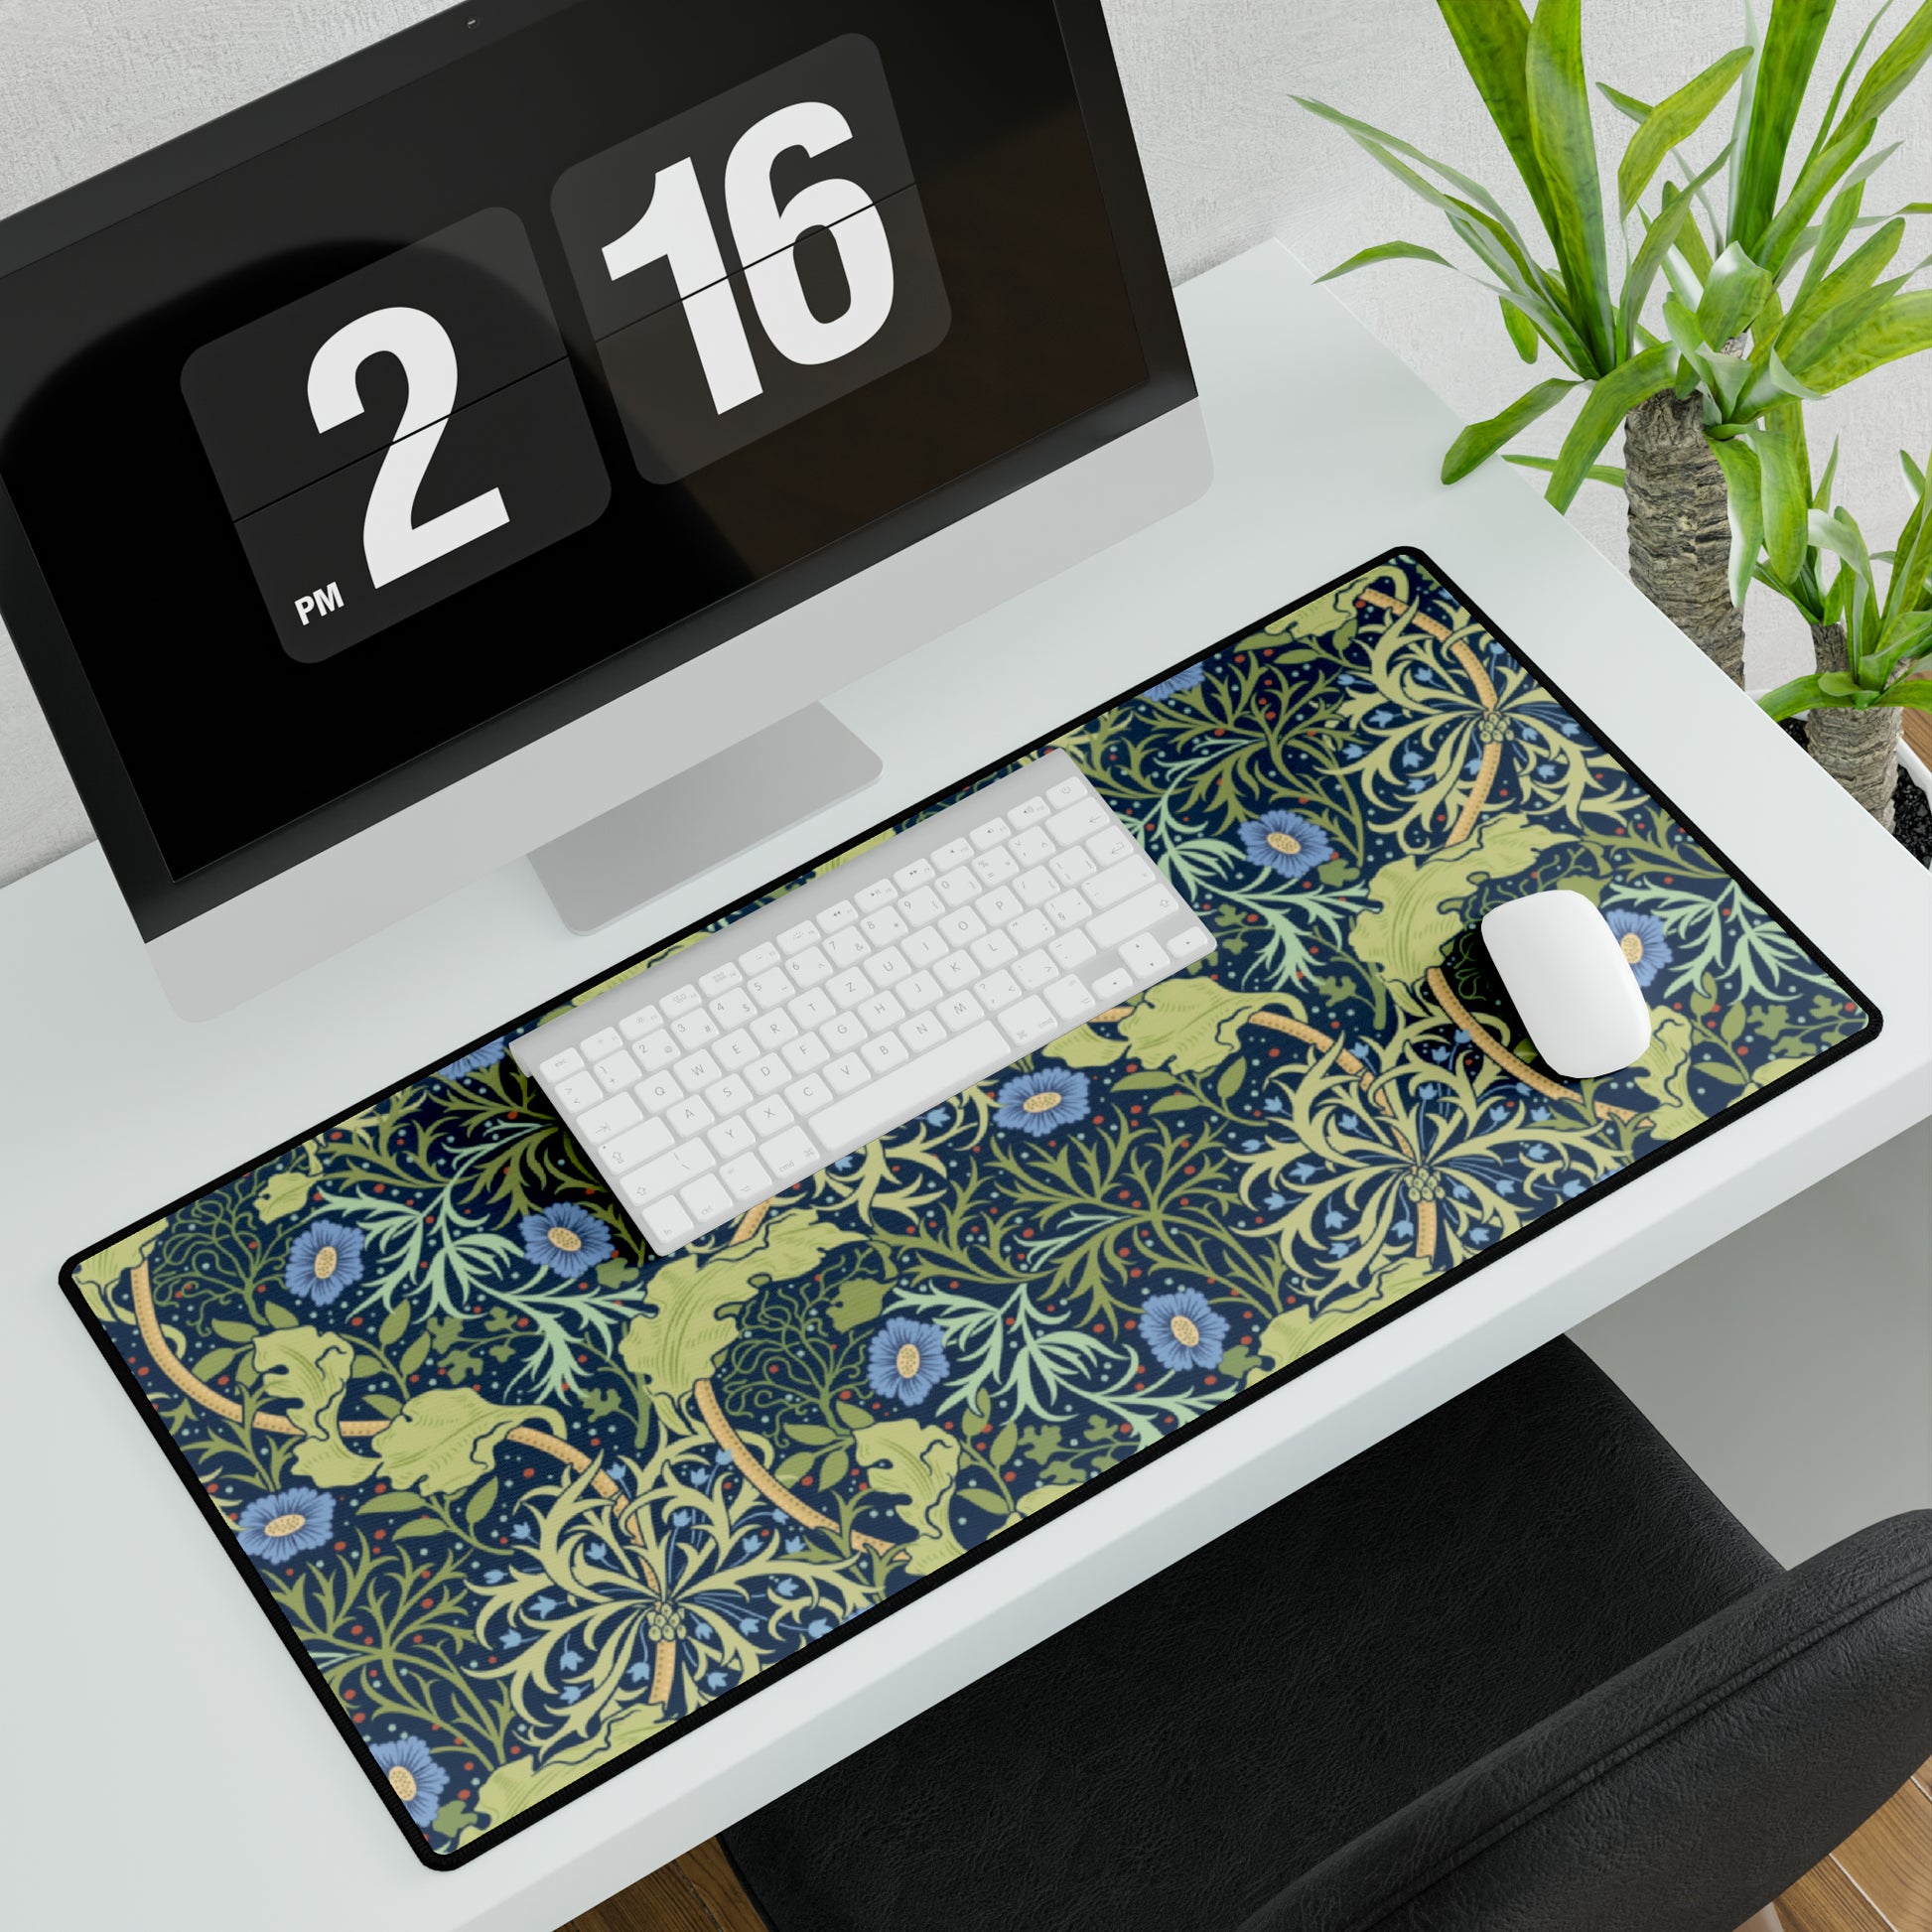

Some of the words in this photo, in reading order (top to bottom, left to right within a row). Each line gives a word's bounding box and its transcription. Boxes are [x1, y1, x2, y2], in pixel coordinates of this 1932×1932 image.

[307, 307, 510, 590] 2
[601, 101, 895, 416] 16
[294, 581, 345, 626] PM
[638, 1043, 648, 1054] 2
[676, 1023, 686, 1034] 3
[716, 1001, 726, 1012] 4
[754, 981, 762, 992] 5
[792, 961, 800, 971] 6
[828, 940, 836, 951] 7
[866, 920, 876, 930] 8
[903, 900, 911, 910] 9
[940, 880, 950, 890] 0
[654, 1086, 666, 1097] Q
[690, 1063, 705, 1076] W
[732, 1043, 742, 1055] E
[769, 1024, 781, 1034] R
[807, 1002, 816, 1013] T
[845, 981, 857, 993] Z
[882, 961, 894, 972] U
[957, 920, 969, 931] O
[995, 900, 1004, 911] P
[684, 1108, 695, 1120] A
[722, 1087, 733, 1097] S
[759, 1065, 771, 1077] D
[798, 1044, 807, 1055] F
[836, 1024, 848, 1035] G
[874, 1003, 887, 1015] H
[949, 961, 962, 973] K
[986, 942, 999, 952] L
[725, 1128, 735, 1139] Y
[762, 1107, 776, 1119] X
[802, 1086, 814, 1097] C
[840, 1064, 851, 1076] V
[878, 1044, 890, 1055] B
[915, 1023, 928, 1035] N
[953, 1002, 968, 1015] M
[778, 1159, 795, 1173] cmd
